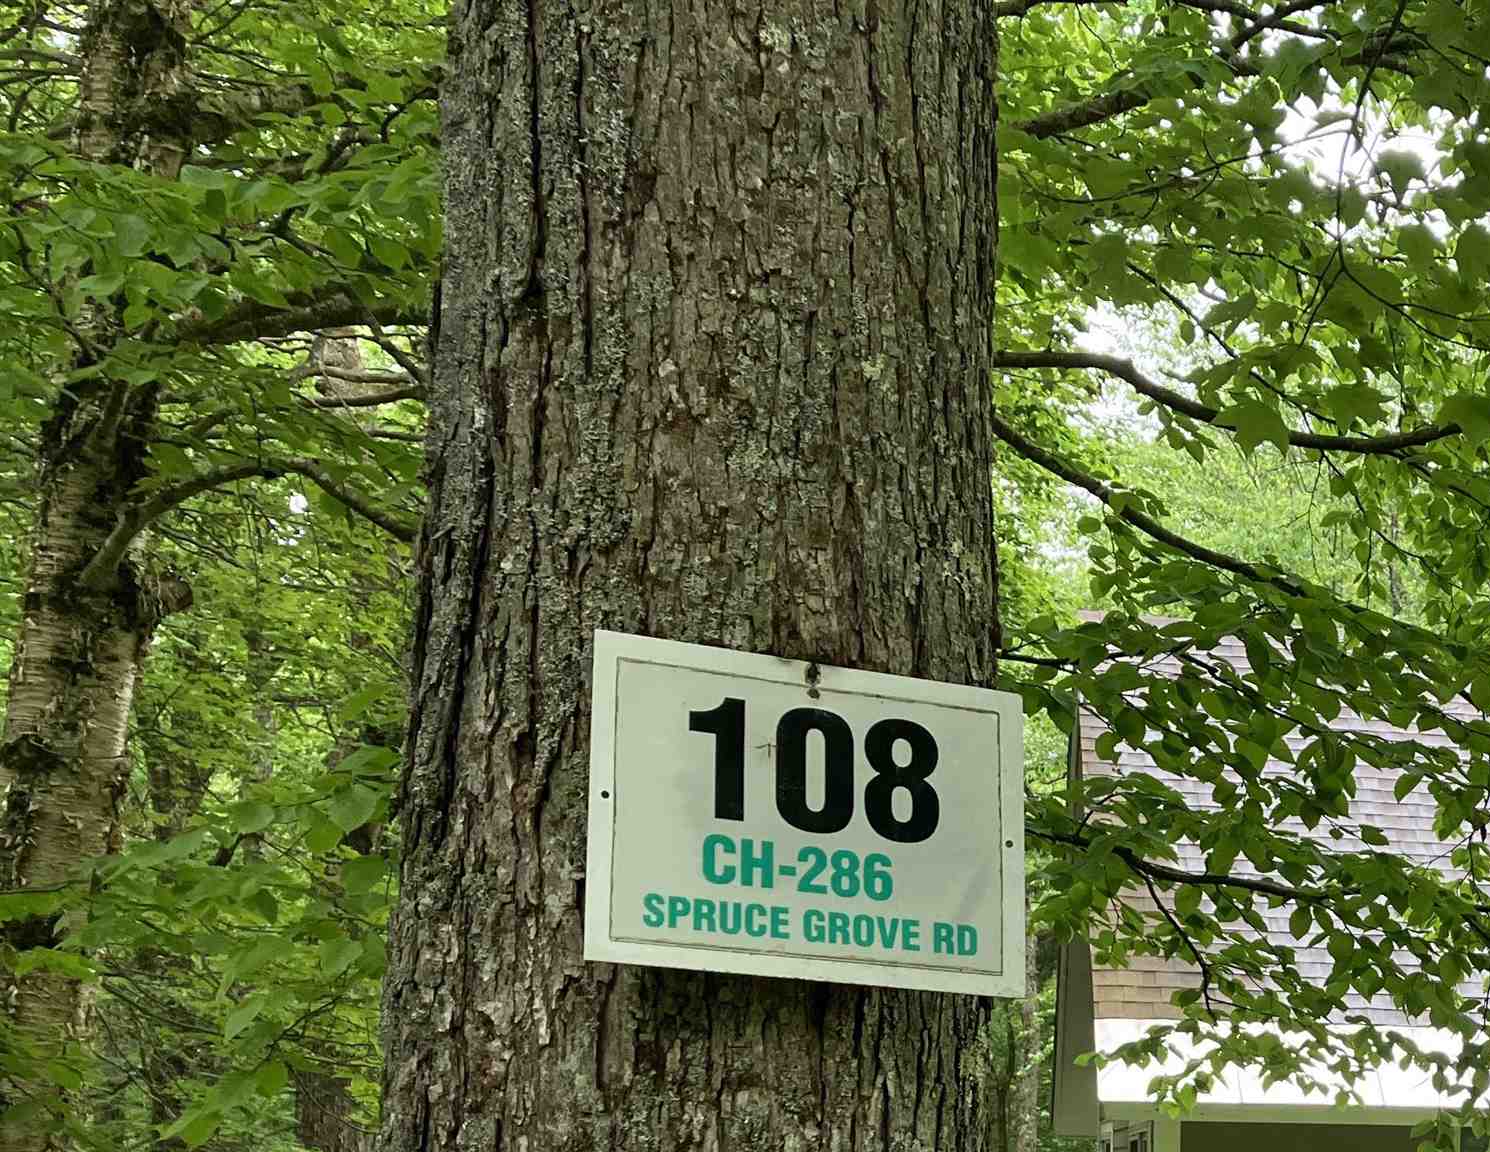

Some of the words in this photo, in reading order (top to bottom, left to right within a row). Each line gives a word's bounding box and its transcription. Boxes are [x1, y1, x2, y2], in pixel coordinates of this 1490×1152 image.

[688, 697, 940, 843] 108
[702, 834, 894, 901] CH-286
[642, 893, 790, 940] SPRUCE
[803, 909, 921, 952] GROVE
[933, 922, 978, 957] RD
